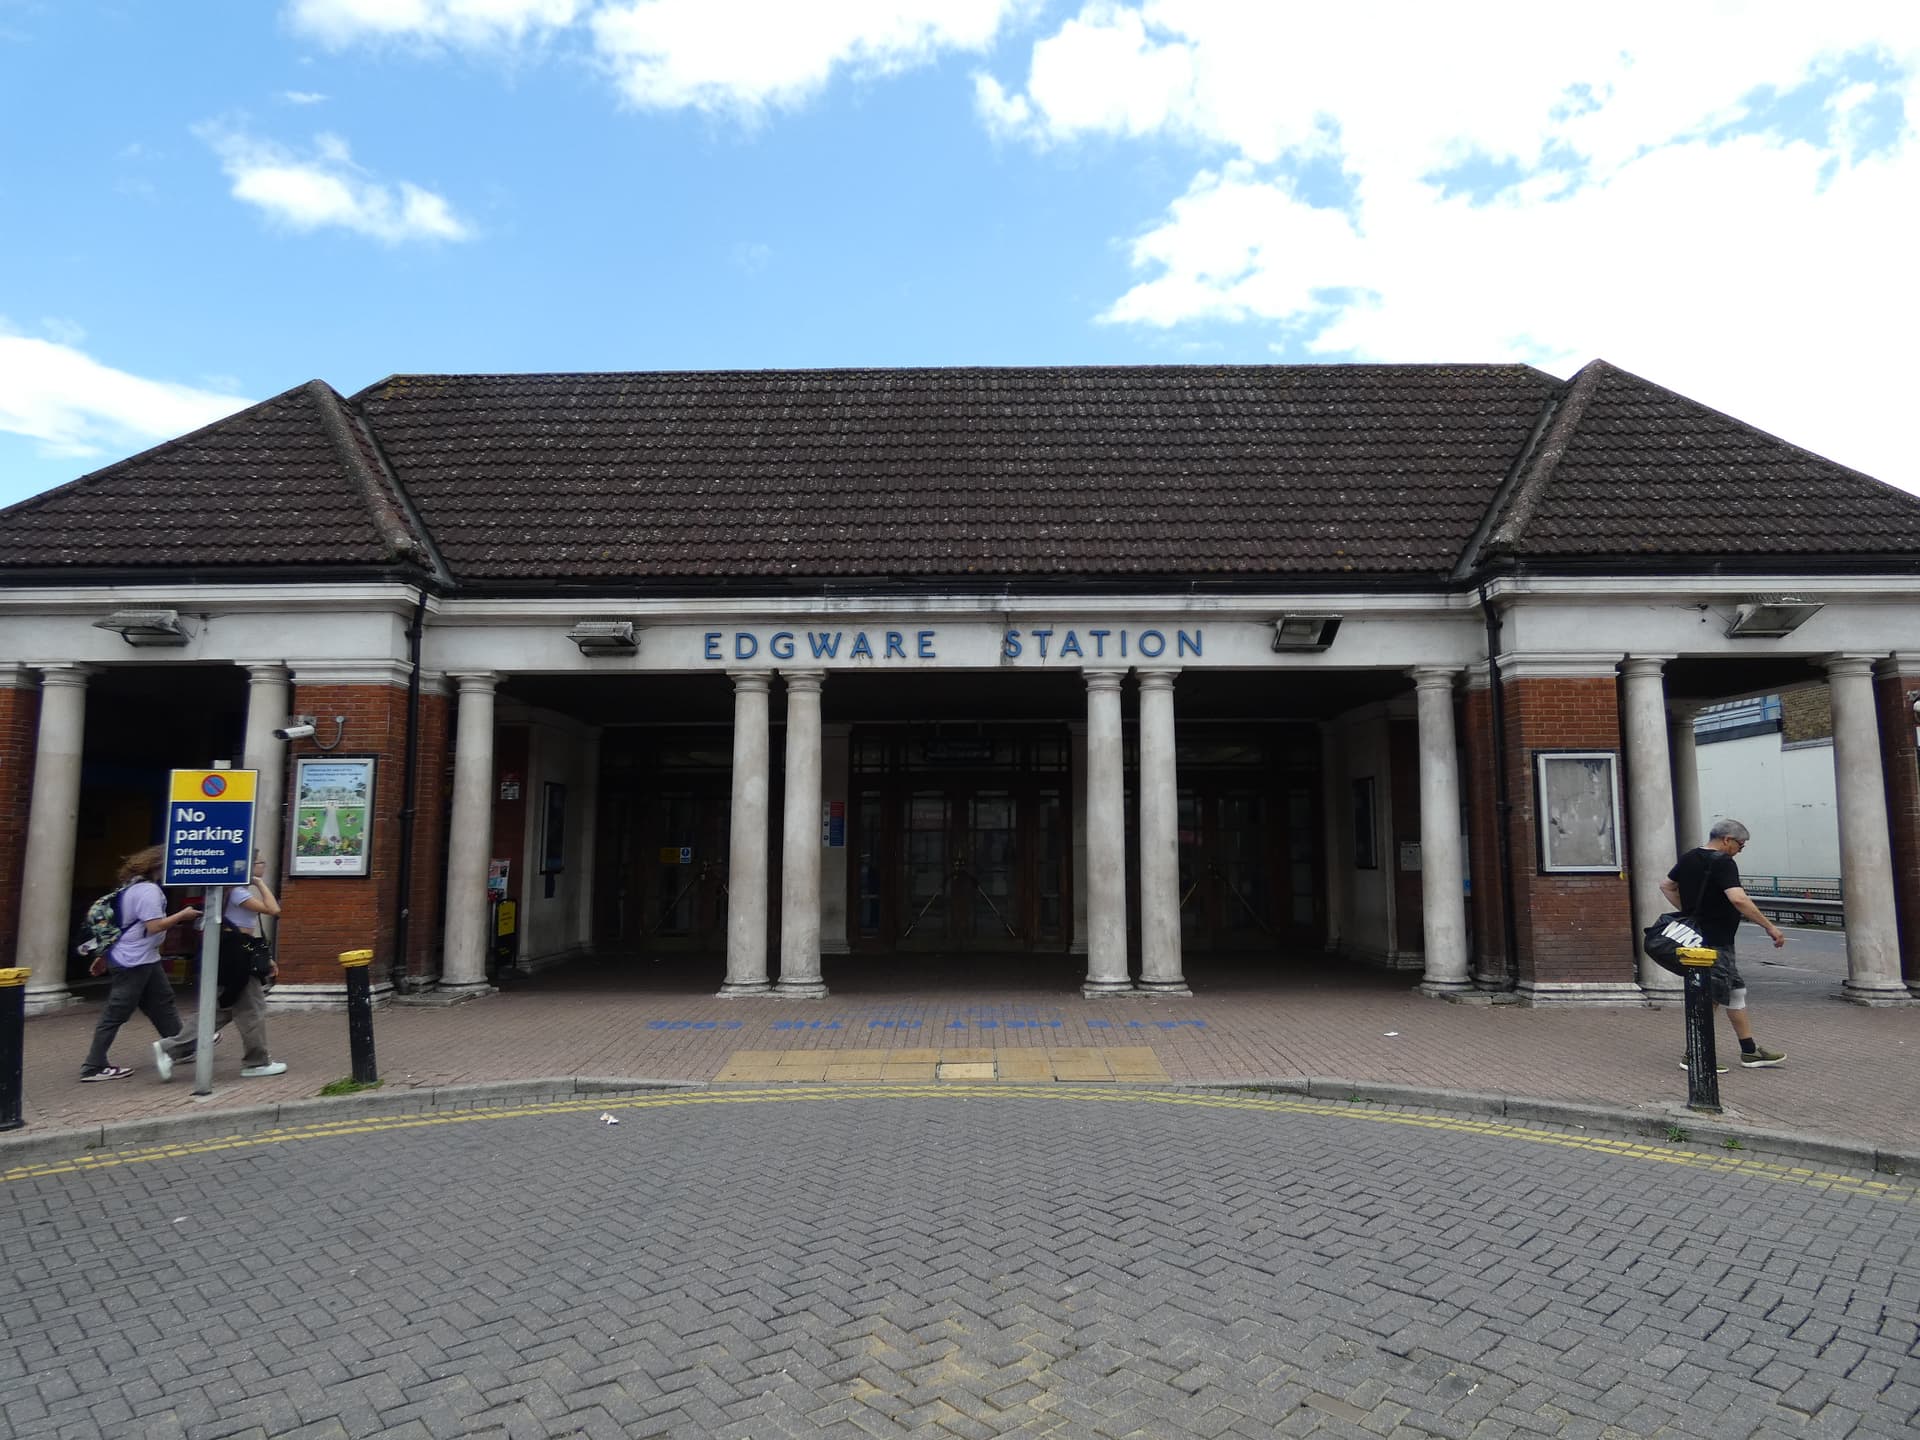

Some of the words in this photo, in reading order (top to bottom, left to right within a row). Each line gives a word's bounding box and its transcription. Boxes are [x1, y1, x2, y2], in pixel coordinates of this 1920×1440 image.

[704, 631, 936, 660] EDGWARE
[1004, 630, 1203, 657] STATION
[176, 808, 206, 822] No
[175, 826, 244, 844] parking
[175, 848, 225, 856] Offenders
[175, 857, 193, 866] will
[194, 857, 207, 865] be
[173, 866, 229, 876] prosecuted
